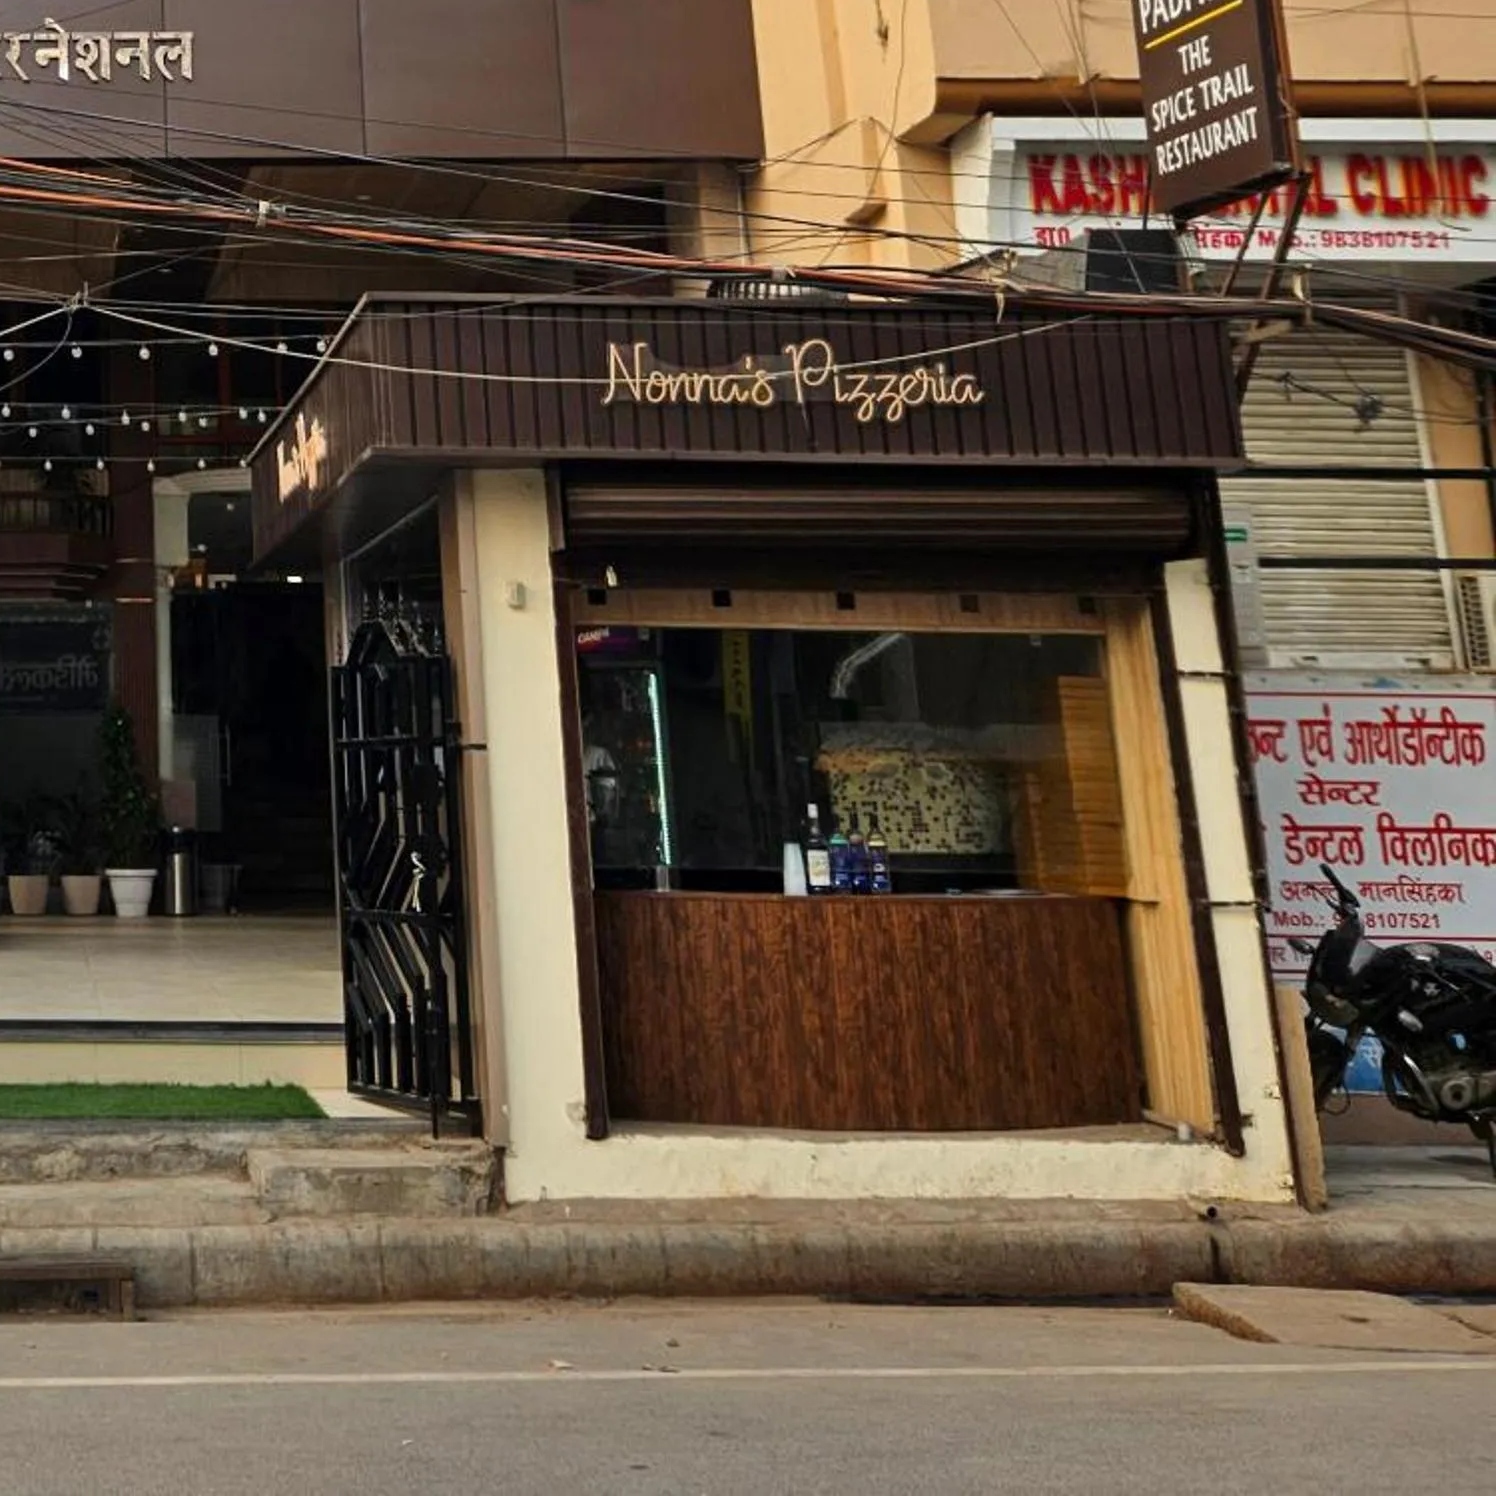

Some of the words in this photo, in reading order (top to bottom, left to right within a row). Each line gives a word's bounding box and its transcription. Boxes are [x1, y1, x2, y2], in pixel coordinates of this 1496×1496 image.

[1177, 35, 1212, 75] THE
[1152, 87, 1198, 132] SPICE
[1198, 63, 1255, 111] TRAIL
[1155, 107, 1258, 176] RESTAURANT
[1345, 154, 1489, 218] CLINIC
[603, 342, 777, 406] Nonna's
[784, 339, 985, 423] Pizzeria
[1296, 703, 1335, 767] एवं
[1296, 772, 1381, 806] सेन्टर
[1280, 813, 1365, 866] डेन्टल
[1273, 911, 1326, 929] Mob.:
